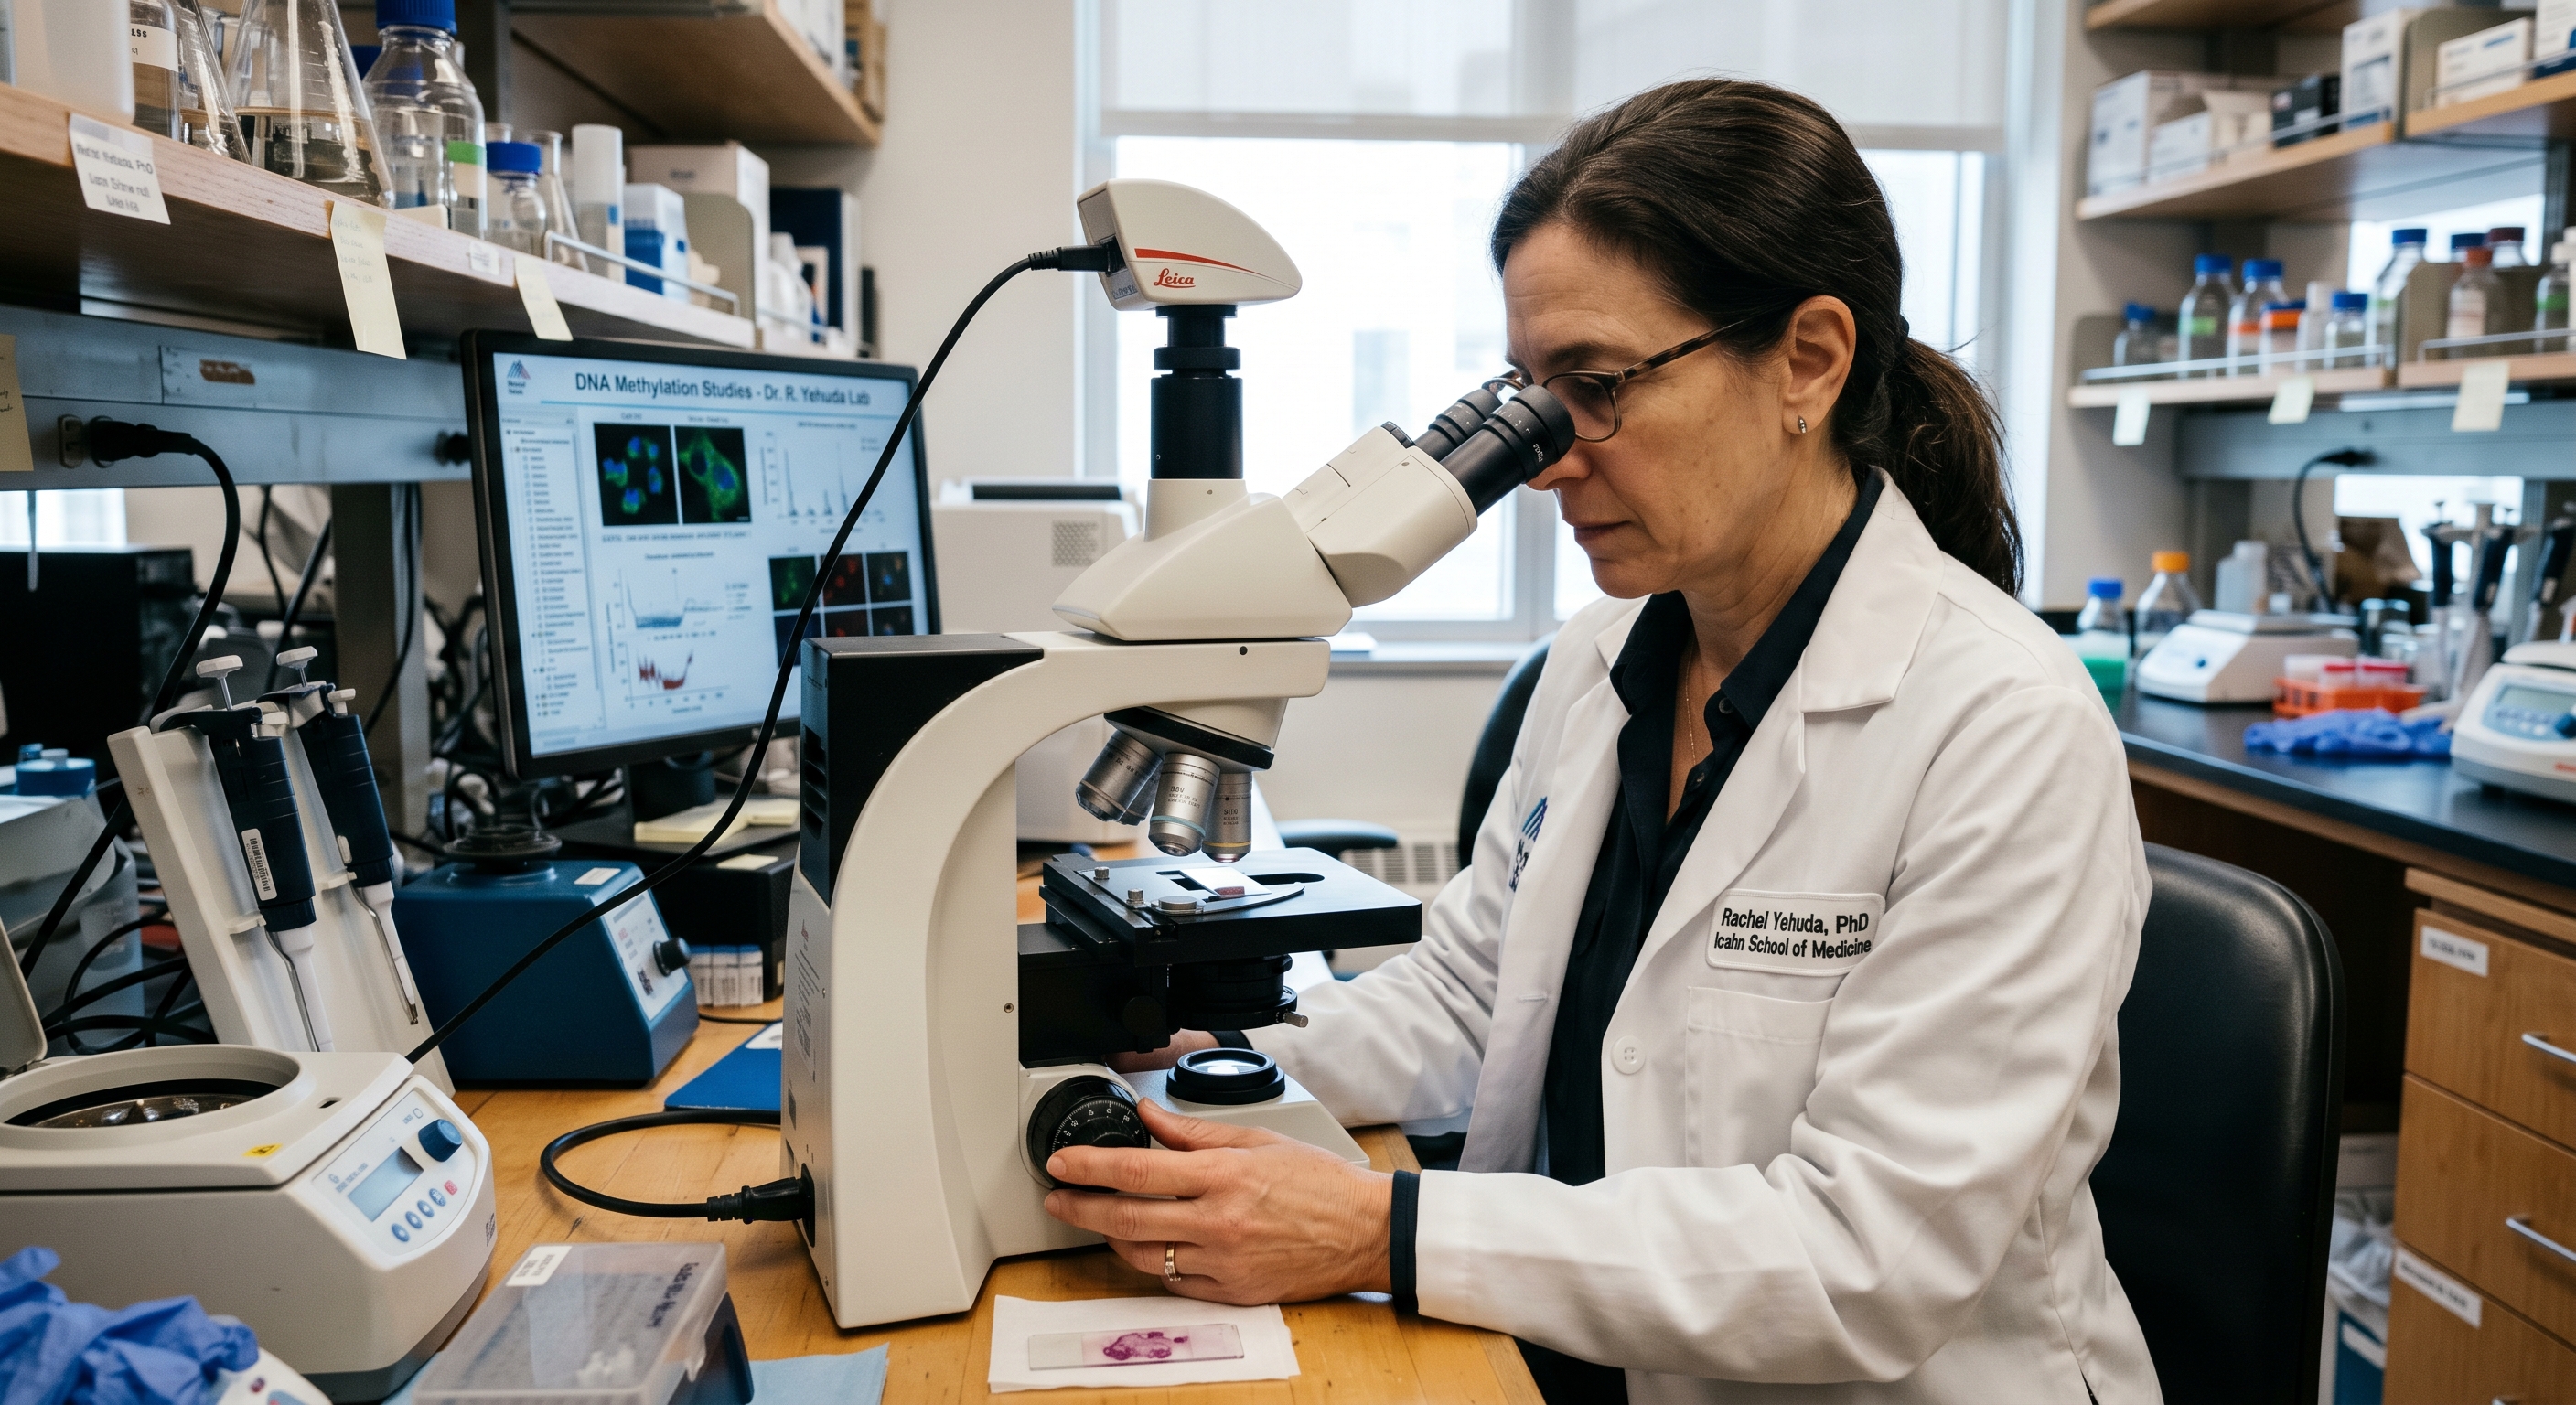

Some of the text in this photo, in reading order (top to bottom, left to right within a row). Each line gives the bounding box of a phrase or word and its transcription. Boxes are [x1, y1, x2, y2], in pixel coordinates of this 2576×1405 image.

[1153, 268, 1196, 288] Leica
[575, 372, 611, 391] DNA
[615, 374, 699, 399] Methylation
[703, 381, 752, 399] Studies
[764, 384, 782, 400] Dr.
[785, 385, 798, 401] R.
[800, 386, 845, 404] Yehuda
[849, 390, 870, 405] Lab
[1721, 907, 1869, 936] Rachel Yehuda, PhD
[1713, 931, 1872, 959] Icahn School of Medicine
